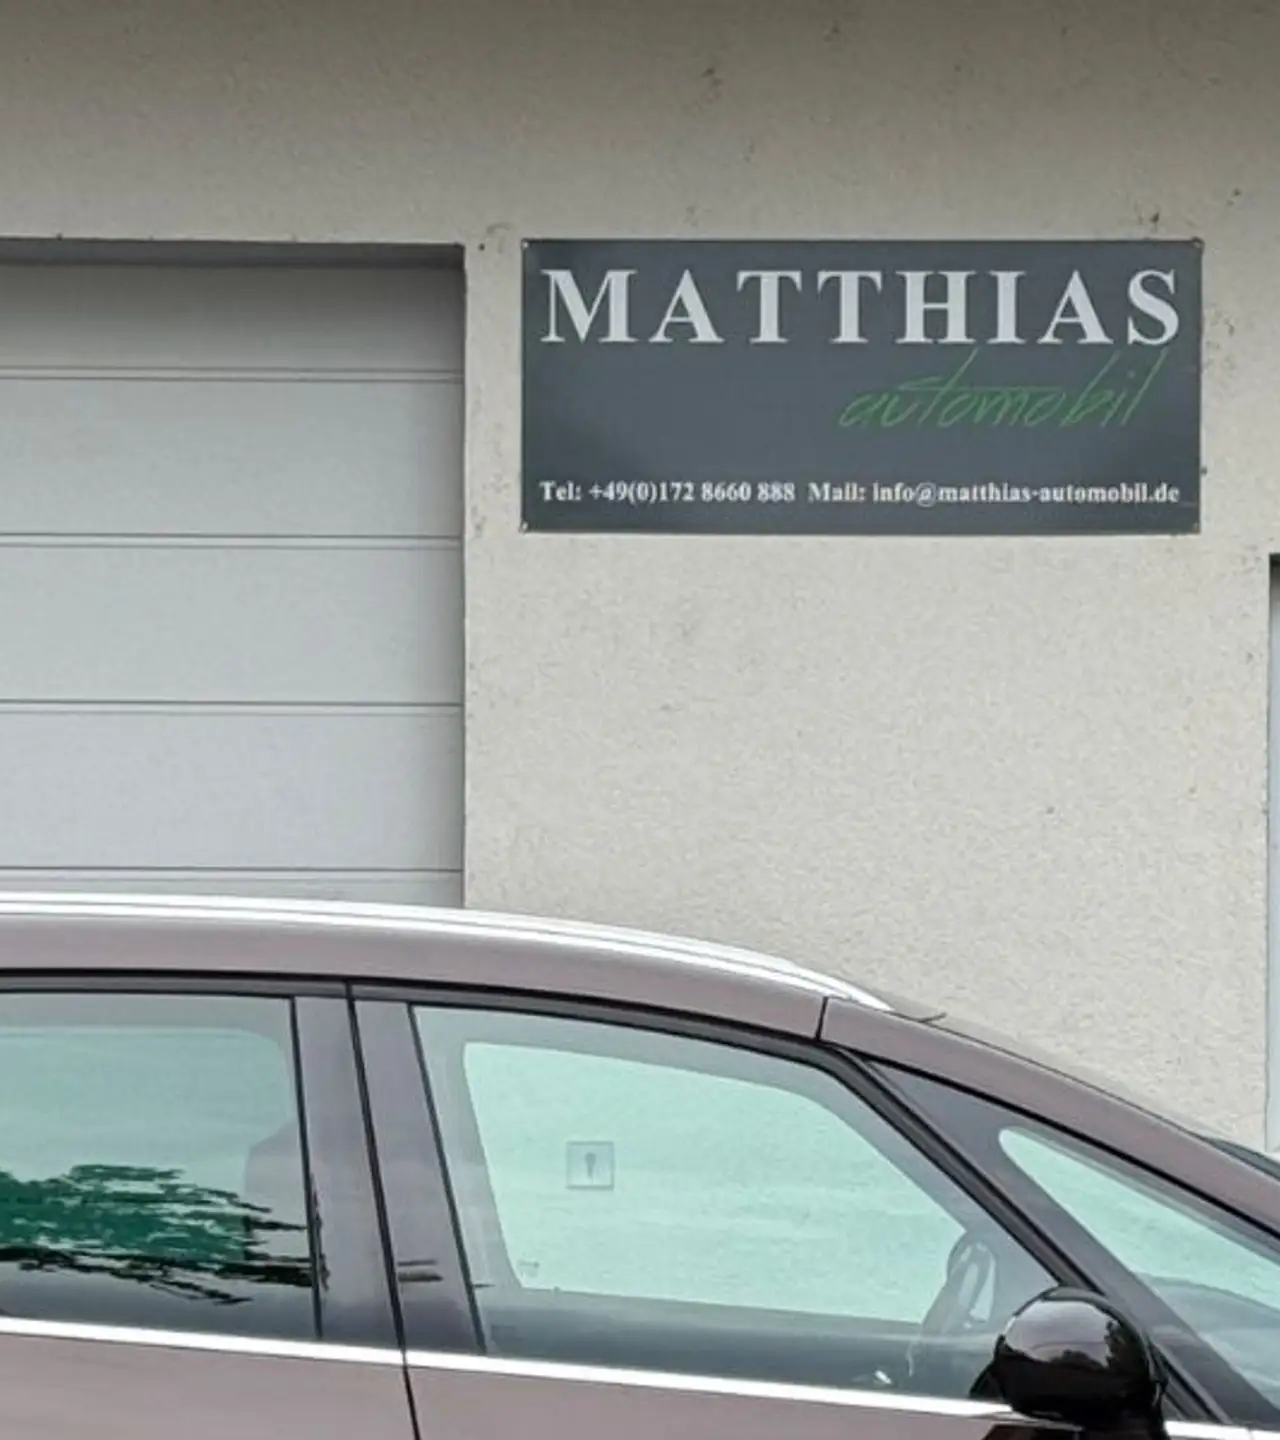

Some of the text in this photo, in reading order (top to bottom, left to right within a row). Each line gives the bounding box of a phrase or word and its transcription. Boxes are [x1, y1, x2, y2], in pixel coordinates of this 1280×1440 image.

[540, 269, 1180, 345] MATTHIAS
[836, 346, 1170, 428] automobil
[539, 480, 1181, 507] Tel: +49(0)172 8660 888 Mail: info@matthias-automobil.de
